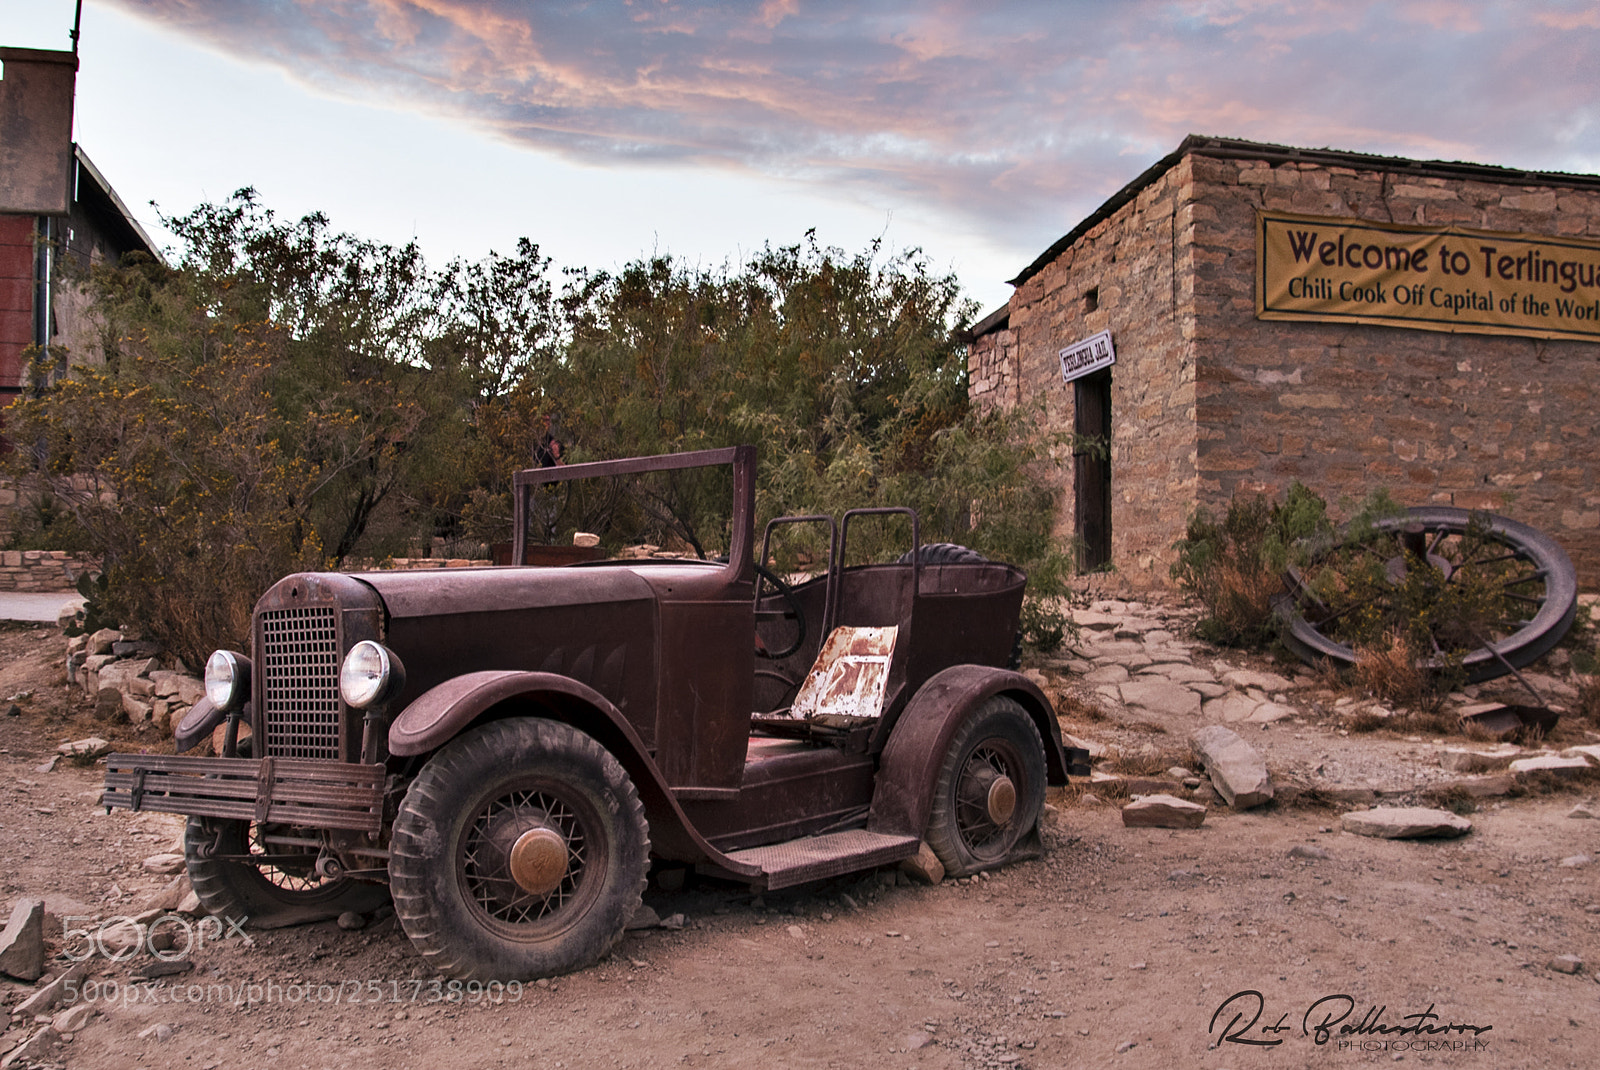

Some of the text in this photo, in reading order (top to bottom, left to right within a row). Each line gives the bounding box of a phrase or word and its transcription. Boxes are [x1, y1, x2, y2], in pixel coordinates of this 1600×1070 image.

[1287, 230, 1428, 272] Welcome
[1439, 245, 1471, 276] to
[1288, 277, 1332, 300] Chili
[1339, 281, 1387, 304] Cook
[1393, 284, 1425, 306] Off
[1429, 287, 1494, 315] Capital
[1499, 297, 1519, 314] of
[1522, 294, 1550, 316] the
